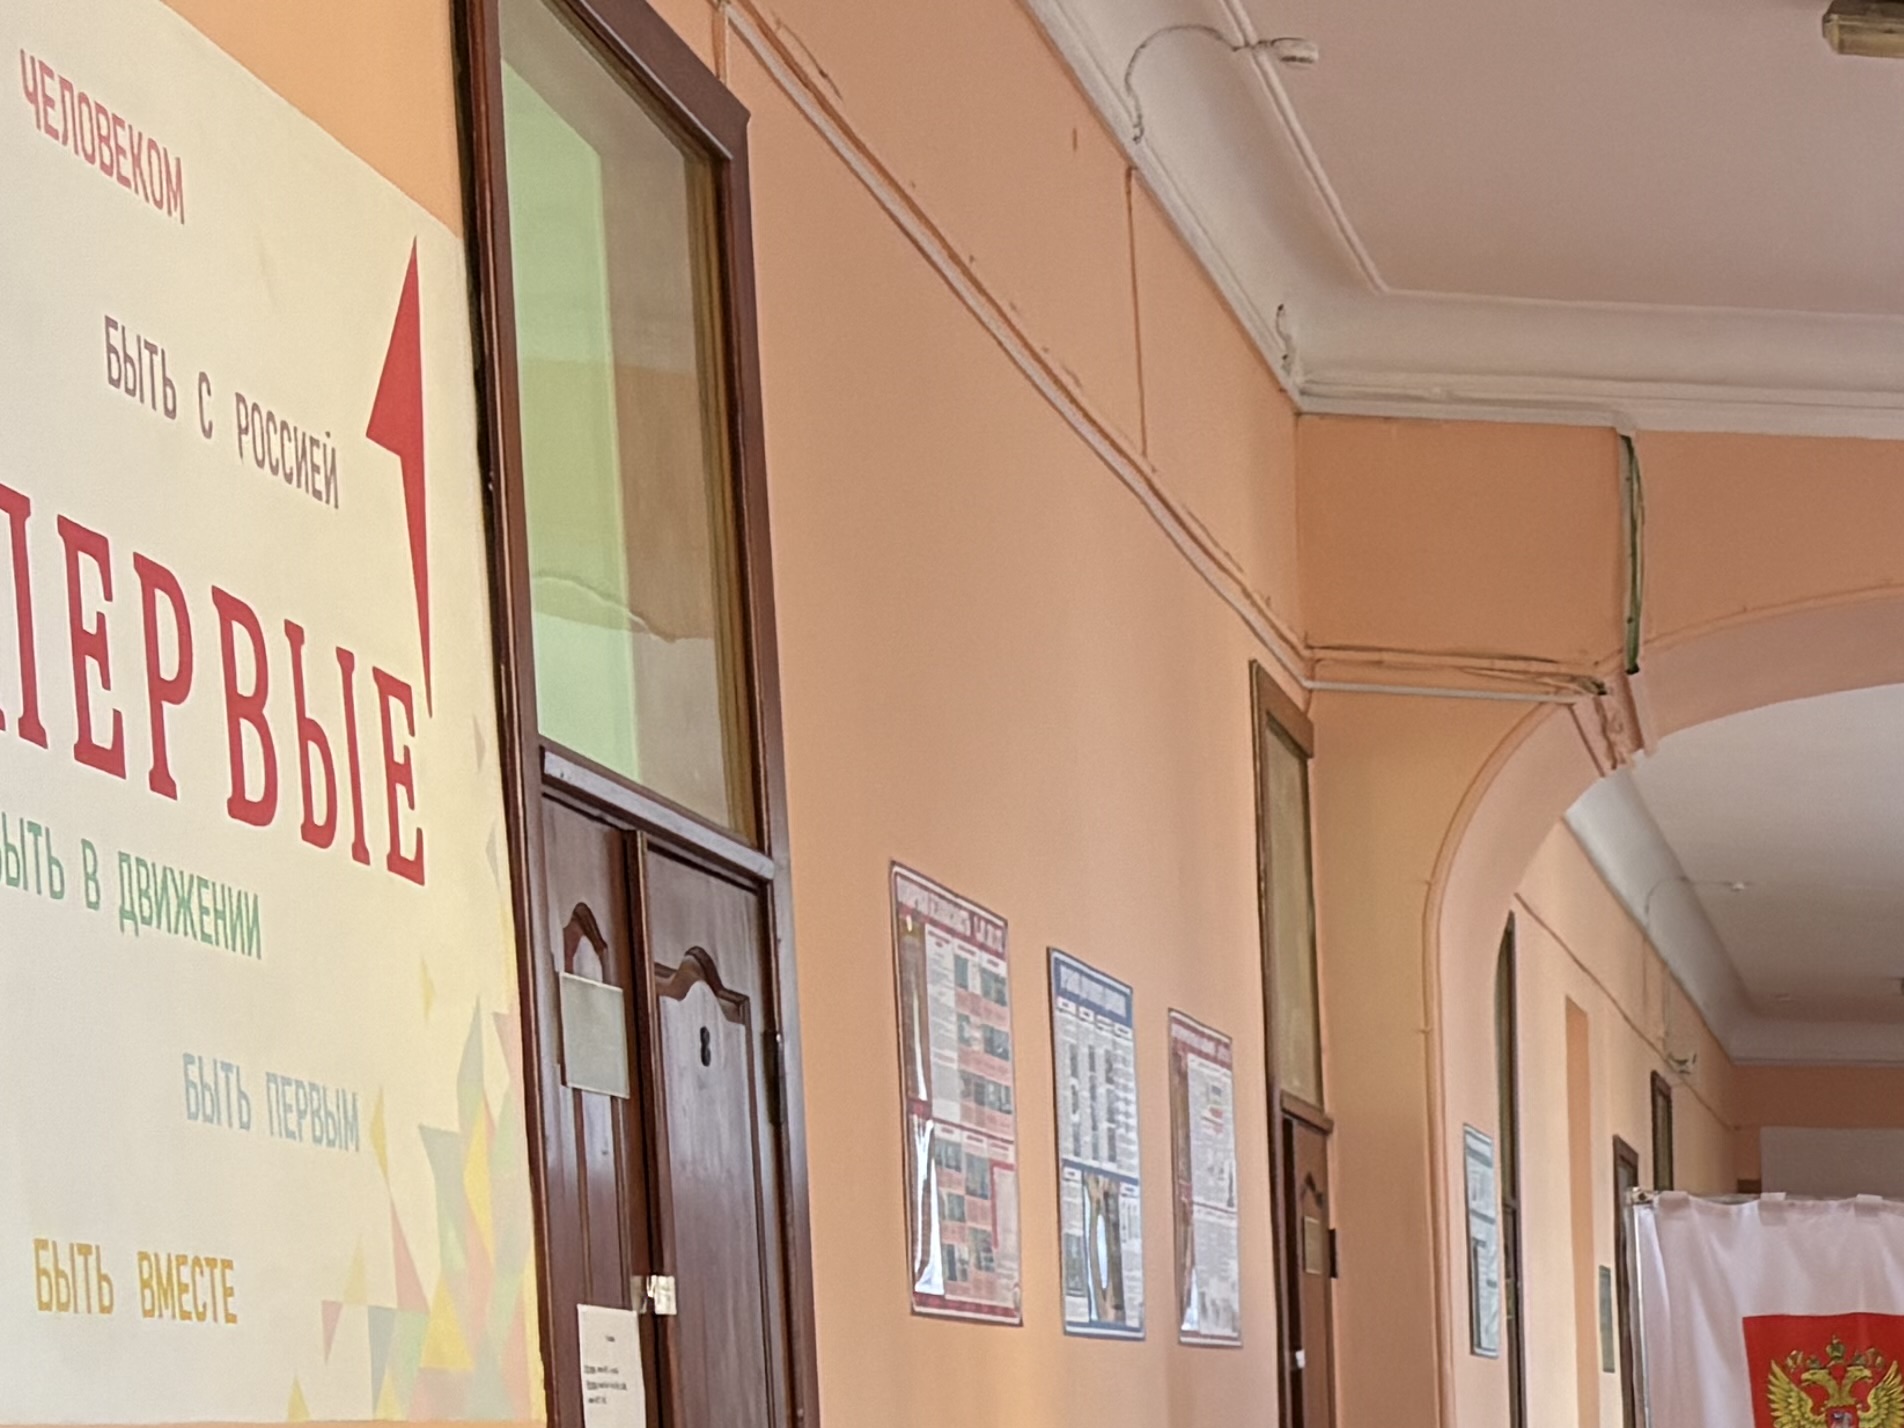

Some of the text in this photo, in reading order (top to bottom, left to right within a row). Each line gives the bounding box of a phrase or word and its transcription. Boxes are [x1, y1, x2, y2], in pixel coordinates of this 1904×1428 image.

[19, 48, 185, 226] ЧЕЛОВЕКОМ
[104, 314, 340, 510] БЫТЬ С РОССИЕЙ
[0, 811, 262, 961] ЫТЬ В ДВИЖЕНИИ
[182, 1052, 360, 1153] БЫТЬ ПЕРВЫМ
[33, 1237, 238, 1325] БЫТЬ ВМЕСТЕ
